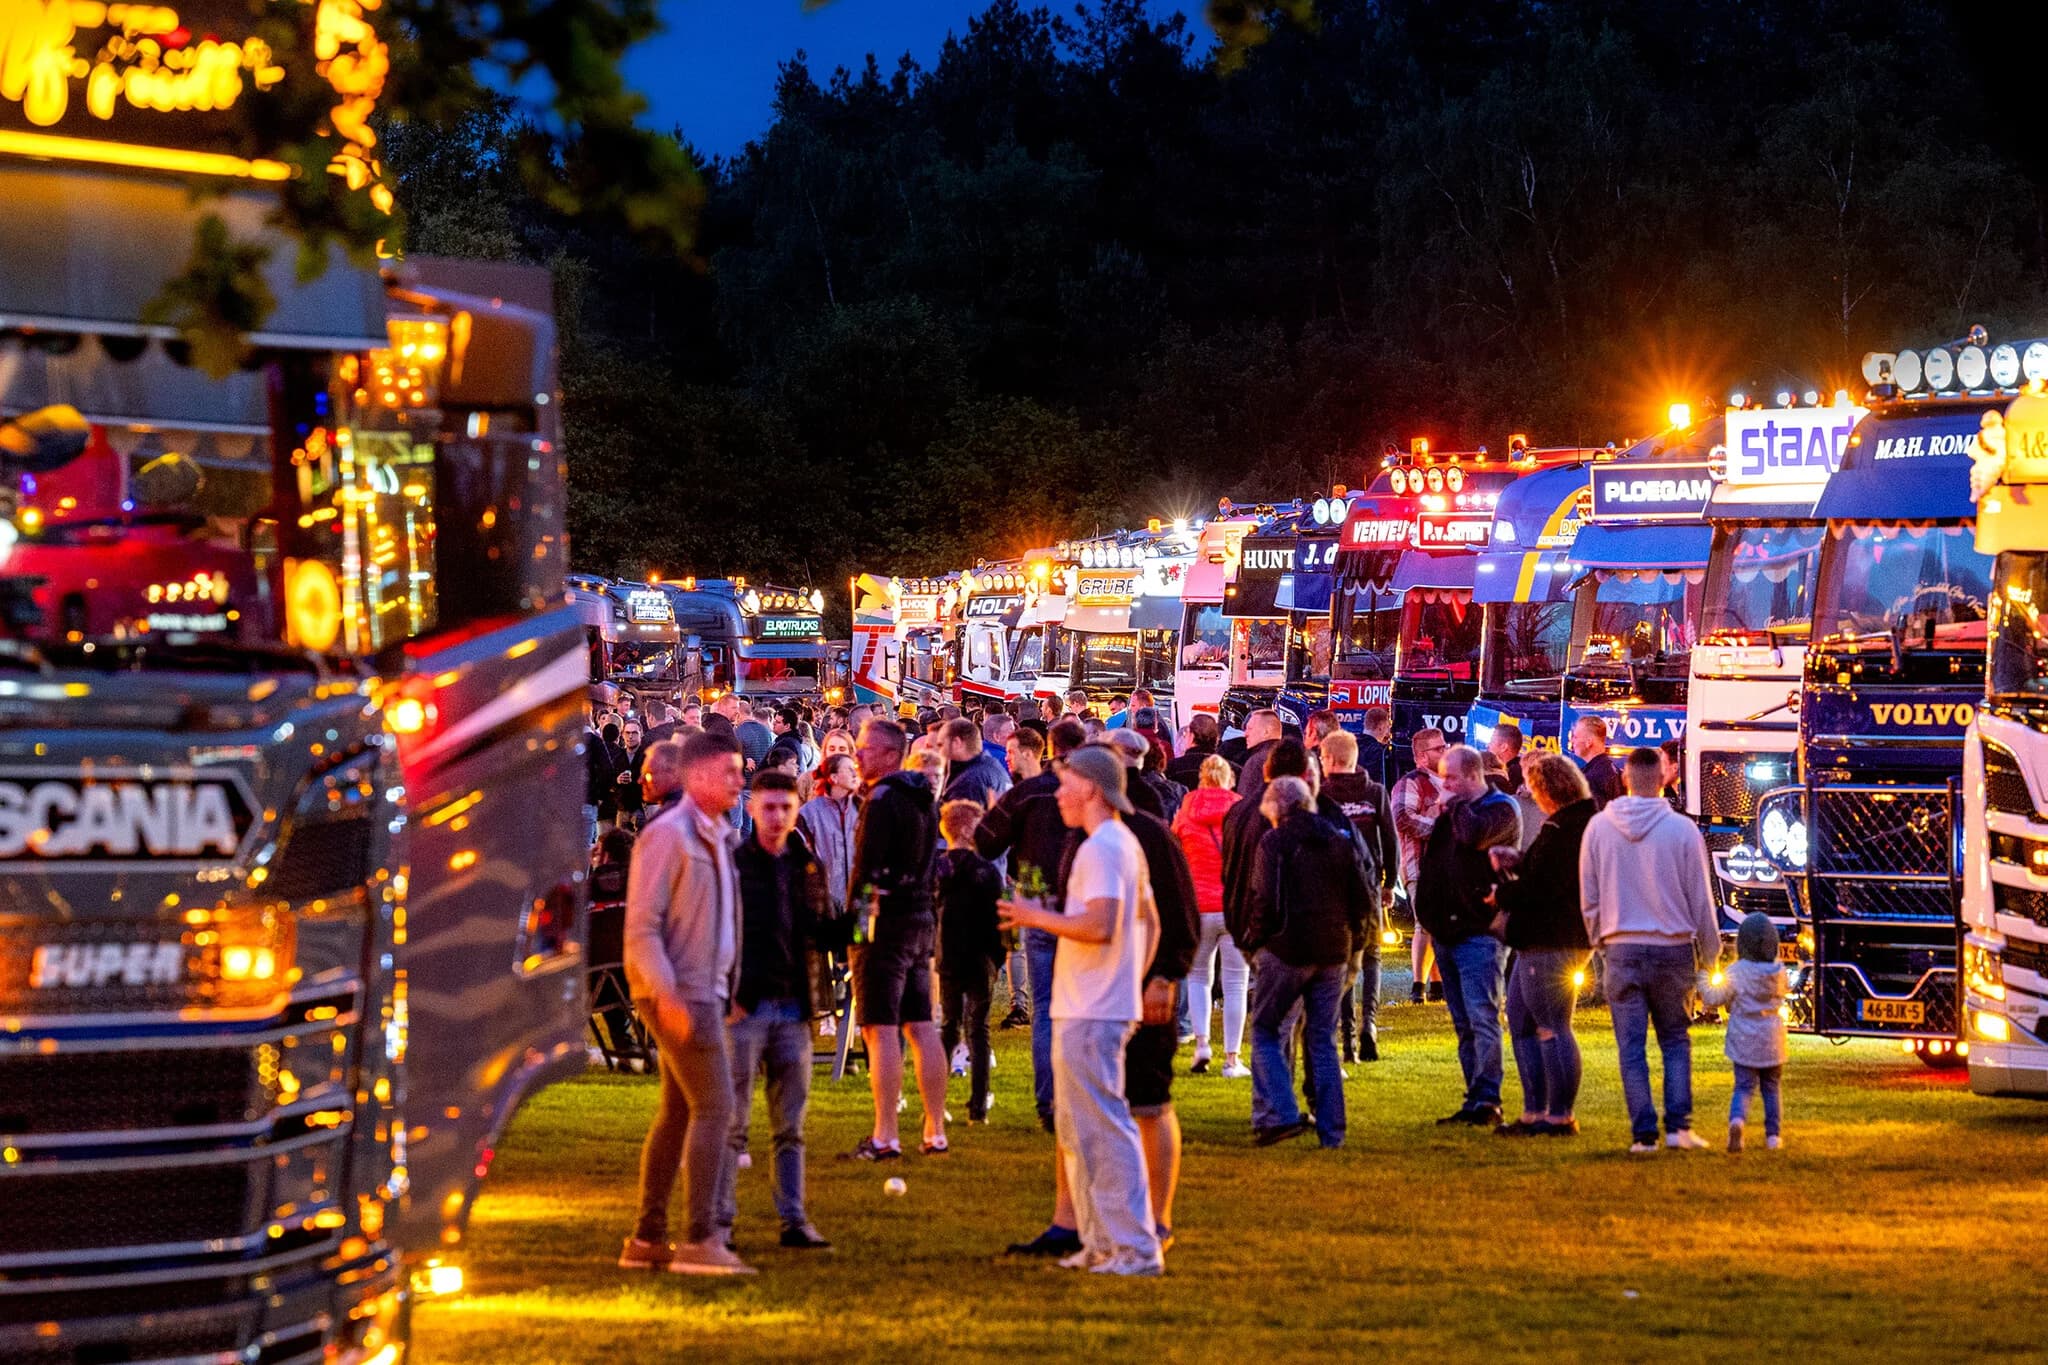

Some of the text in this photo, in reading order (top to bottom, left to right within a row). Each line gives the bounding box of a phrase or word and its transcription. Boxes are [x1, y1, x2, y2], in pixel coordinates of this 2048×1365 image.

[1927, 434, 1979, 456] ROM
[1605, 480, 1711, 502] PLOEGAM
[1304, 544, 1319, 564] J.
[766, 620, 818, 631] EUROTRUCKS
[1336, 713, 1362, 723] DAF
[1869, 703, 1974, 726] VOLVO
